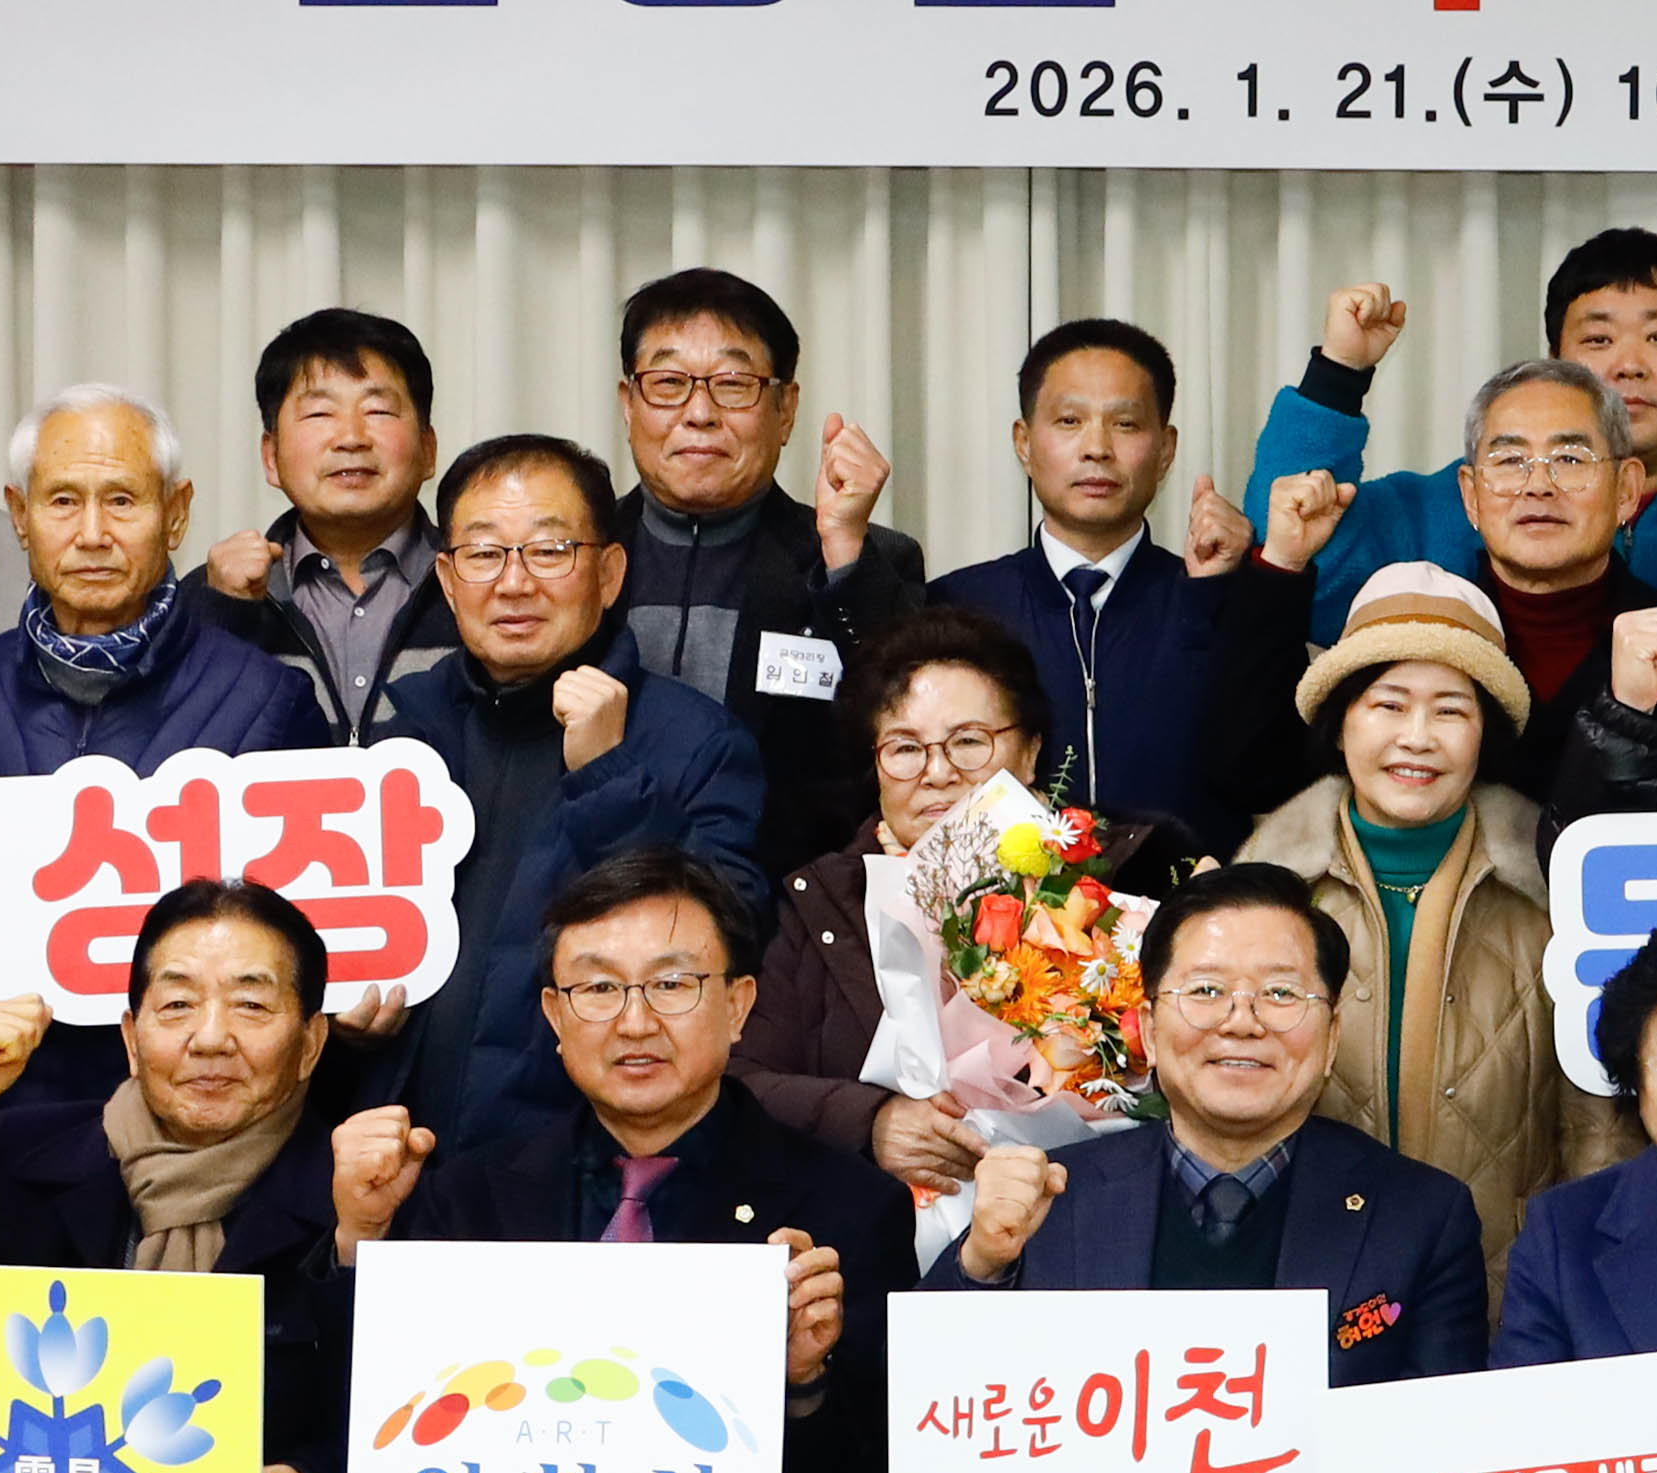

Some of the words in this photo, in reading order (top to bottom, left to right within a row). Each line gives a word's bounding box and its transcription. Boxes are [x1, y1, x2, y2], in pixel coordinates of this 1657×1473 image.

[984, 60, 1189, 121] 2026.
[1237, 63, 1290, 121] 1.
[1335, 56, 1574, 128] 21.(수)
[32, 767, 444, 996] 성장
[917, 1377, 1062, 1460] 새로운
